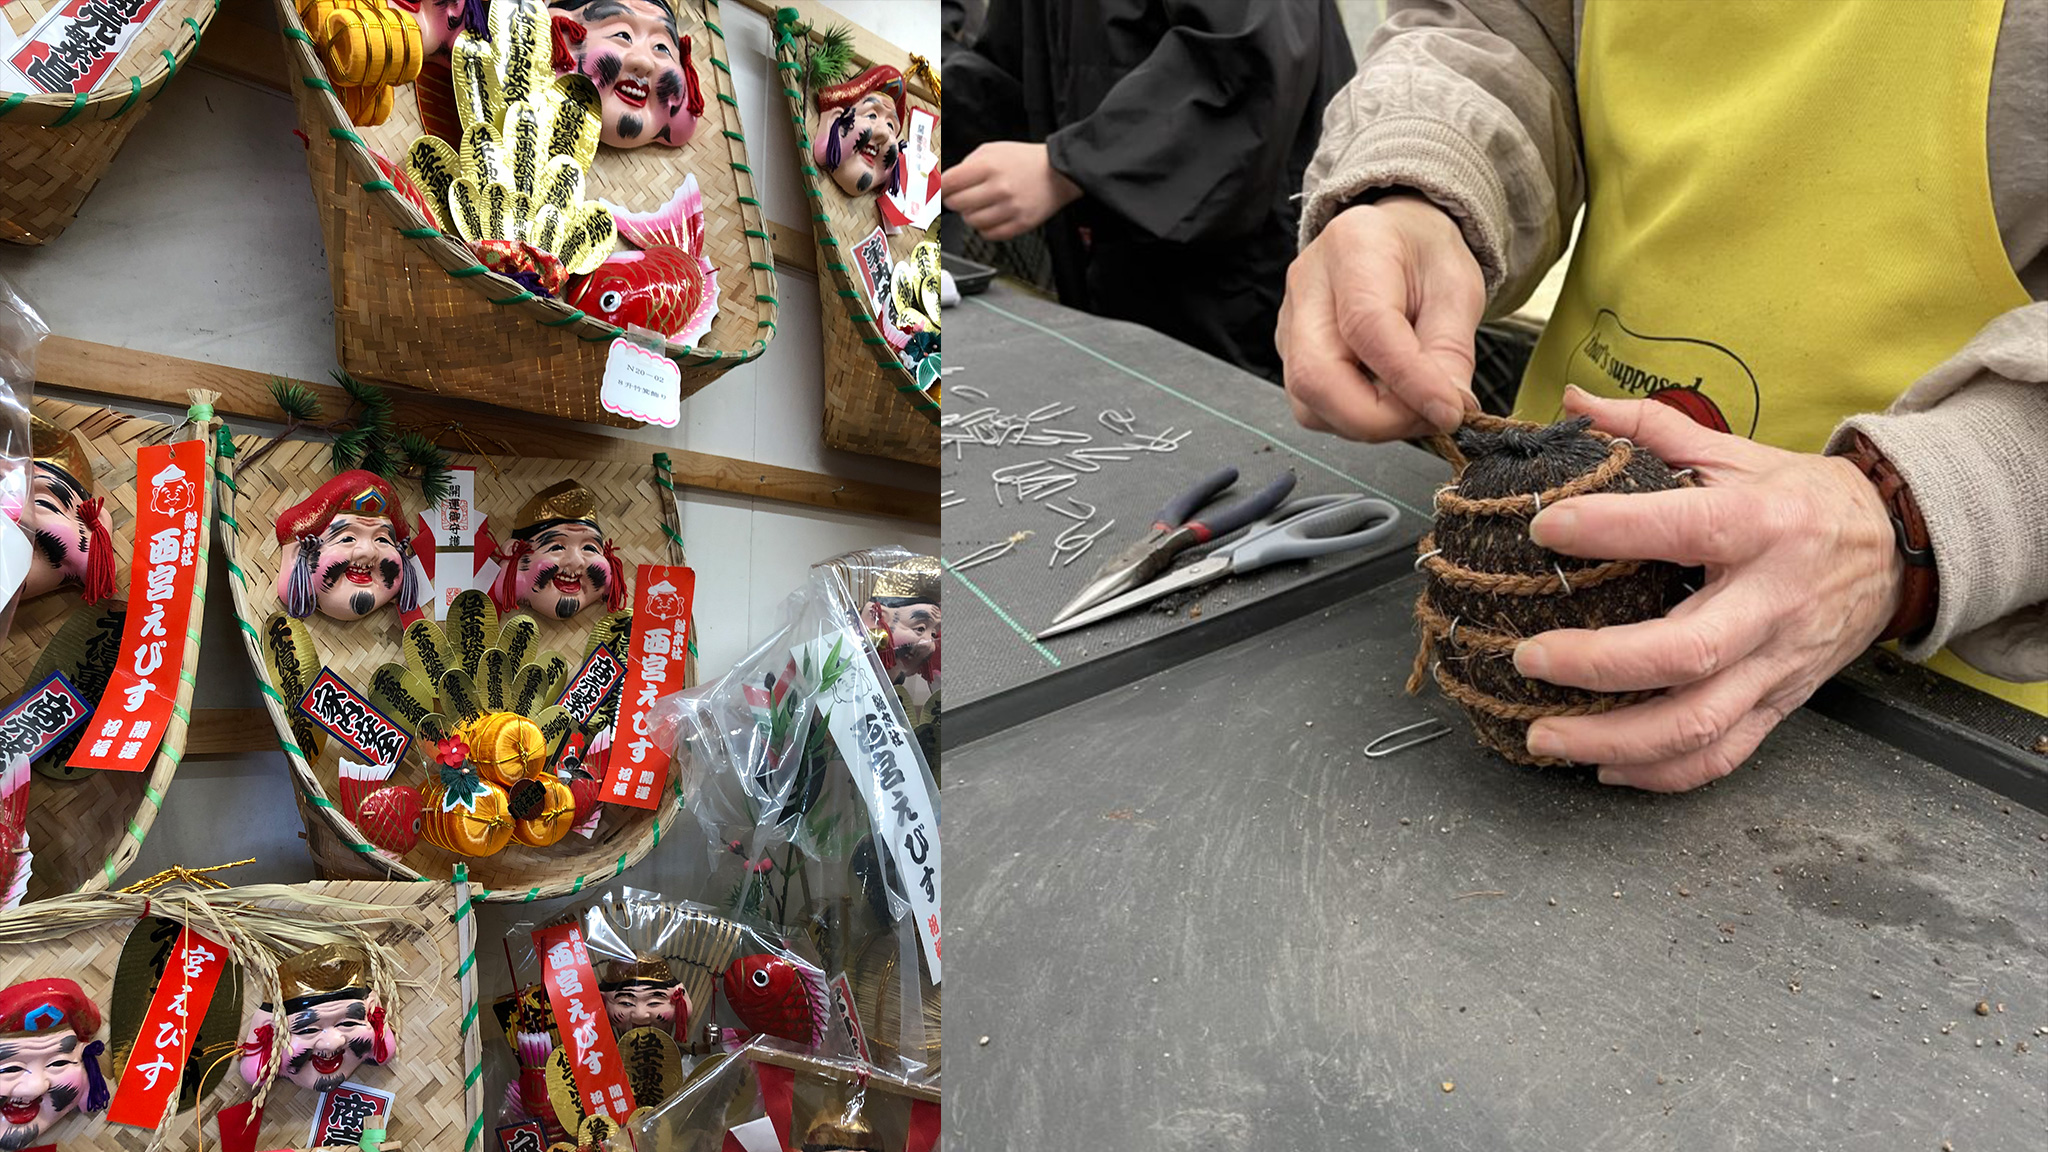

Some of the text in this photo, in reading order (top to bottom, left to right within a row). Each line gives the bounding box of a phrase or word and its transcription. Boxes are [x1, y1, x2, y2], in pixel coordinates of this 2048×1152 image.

[123, 527, 182, 713] 西宮えびす
[90, 719, 124, 758] 招福
[118, 720, 152, 760] 開運
[547, 941, 604, 1075] 西宮えびす
